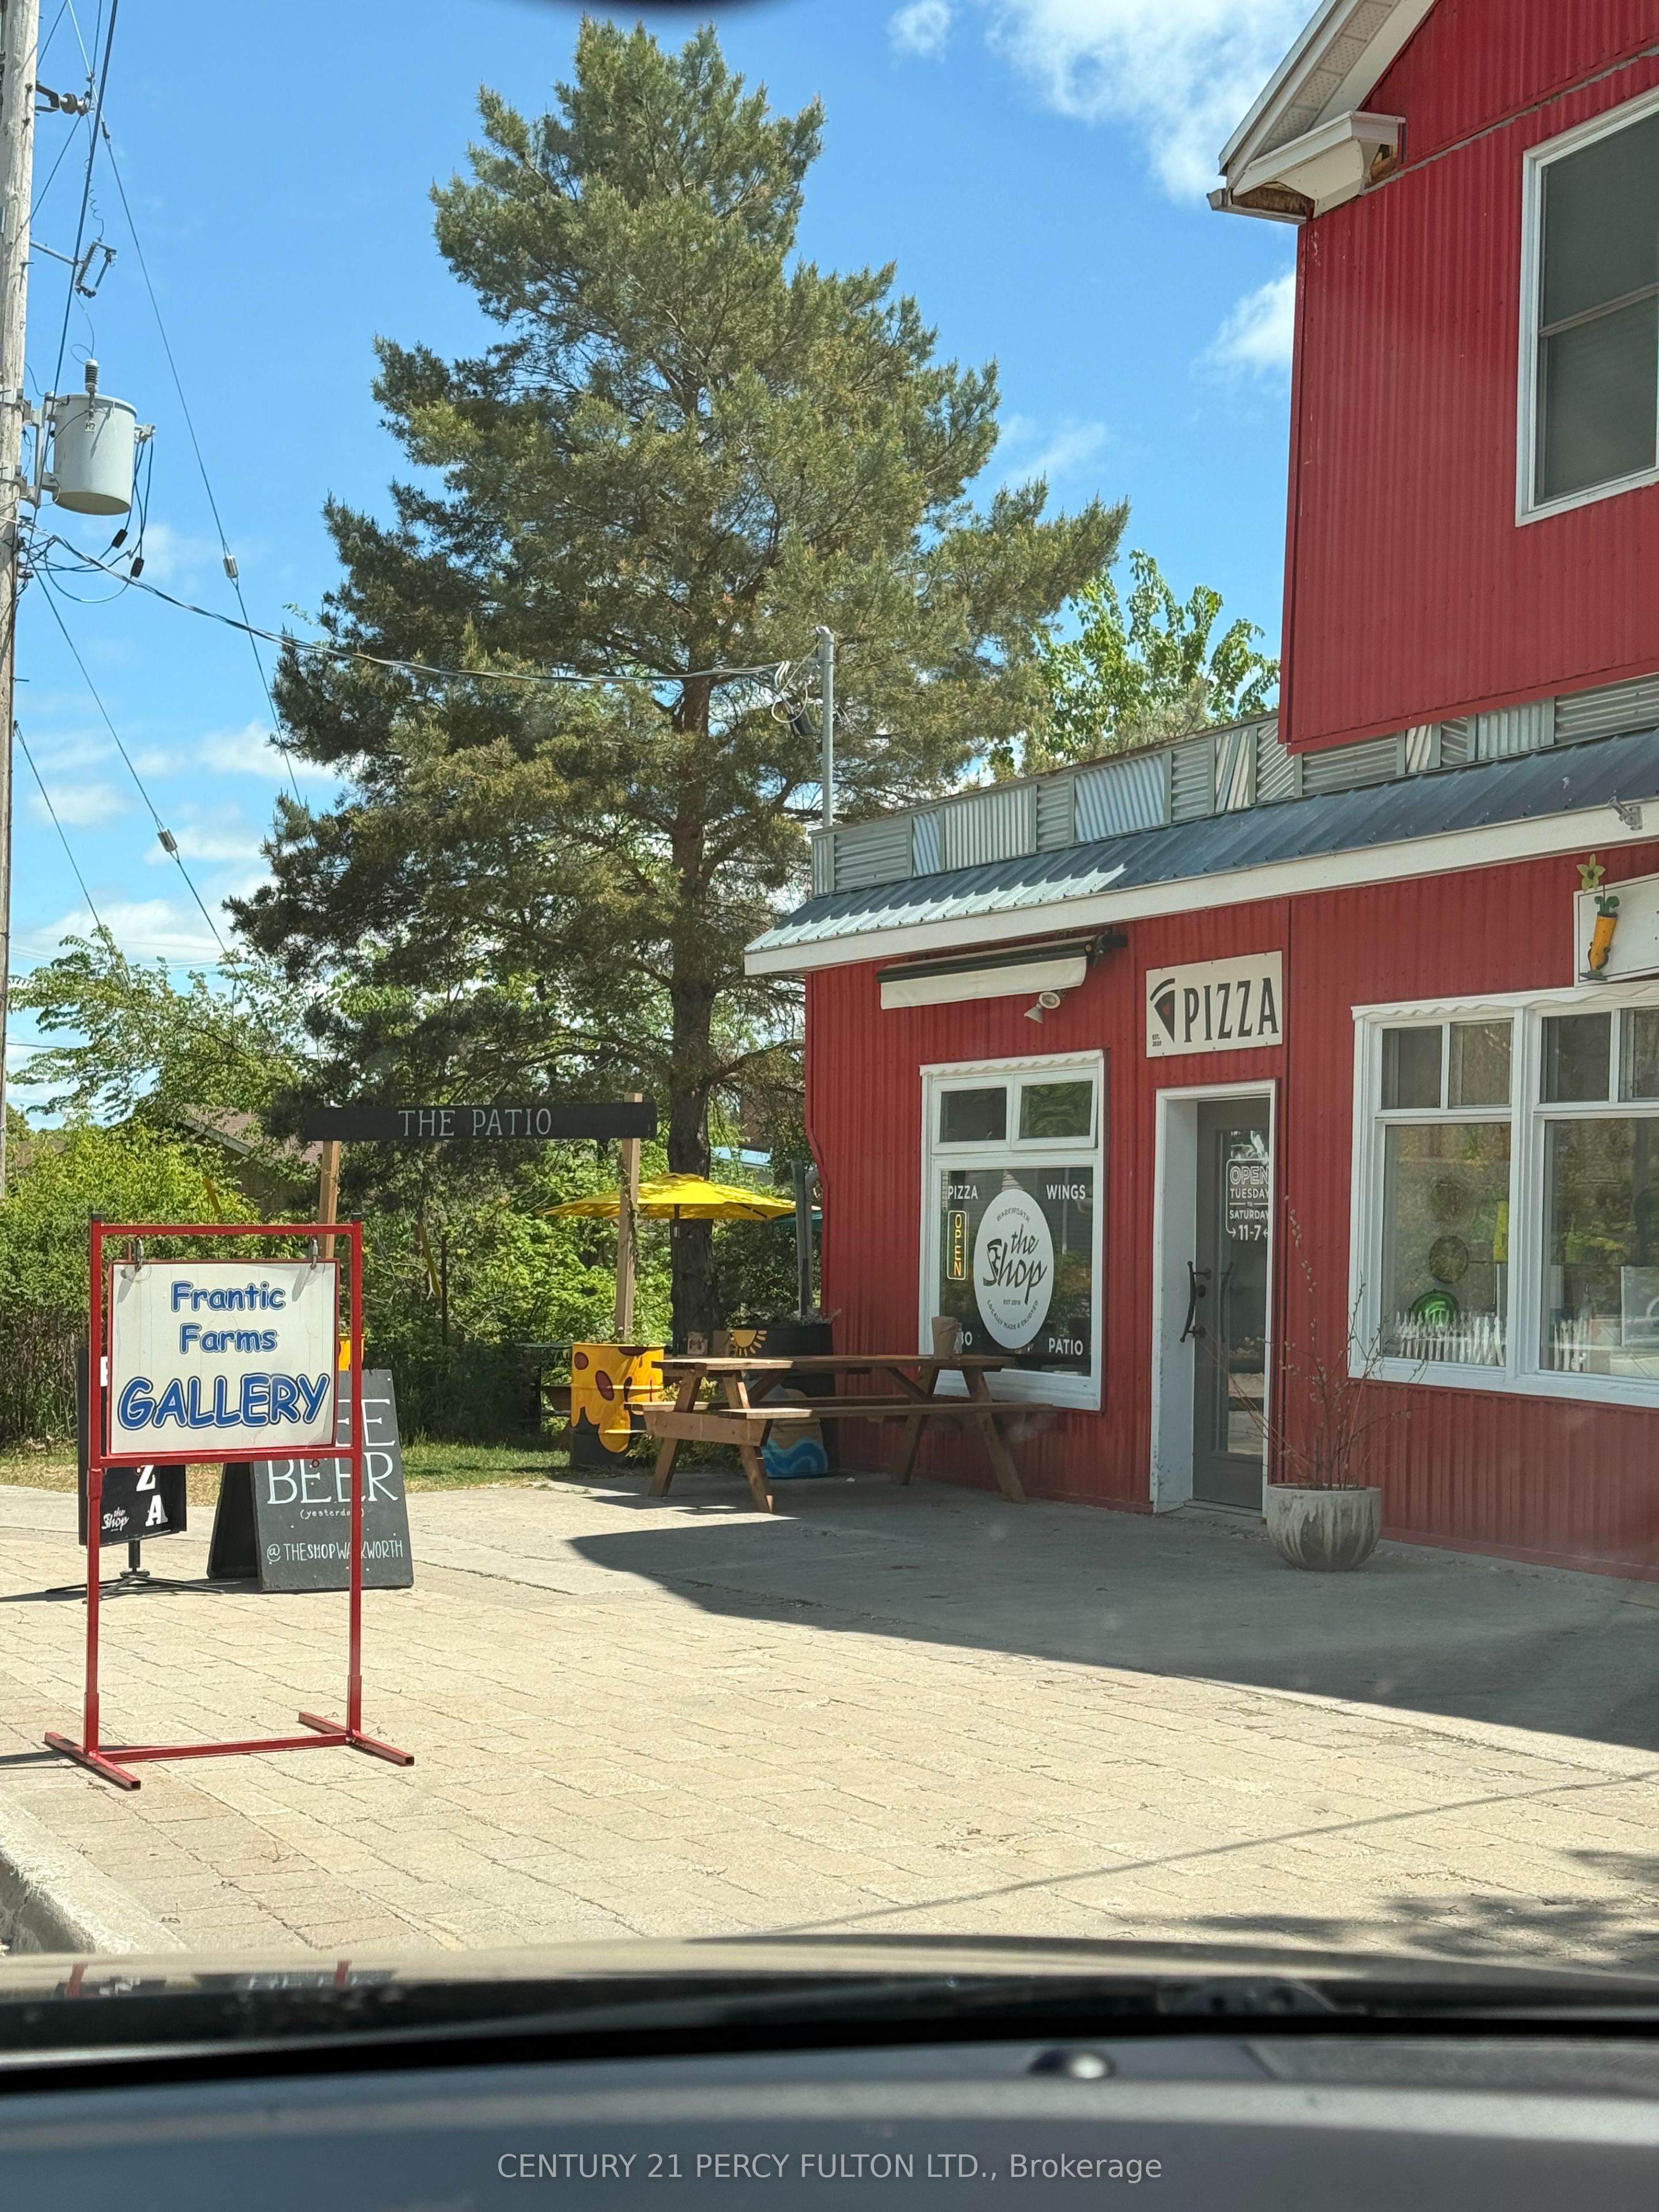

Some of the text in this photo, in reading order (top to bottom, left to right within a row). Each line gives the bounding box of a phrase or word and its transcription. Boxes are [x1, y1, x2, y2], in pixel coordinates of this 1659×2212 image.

[85, 422, 96, 430] H2
[1183, 978, 1279, 1043] PIZZA
[397, 1108, 551, 1137] THE PATIO
[1229, 1166, 1269, 1185] OPEN
[948, 1185, 978, 1200] PIZZA
[1046, 1184, 1086, 1200] WINGS
[954, 1214, 962, 1277] OPEN
[1010, 1223, 1040, 1255] the
[1238, 1225, 1261, 1241] 11-7
[983, 1238, 1048, 1306] Shop
[171, 1281, 286, 1312] Frantic
[179, 1323, 278, 1355] Farms
[1048, 1337, 1084, 1356] PATIO
[117, 1373, 330, 1430] GALLERY
[267, 1452, 399, 1505] BEER
[101, 1513, 130, 1532] Shop
[113, 1507, 126, 1517] the
